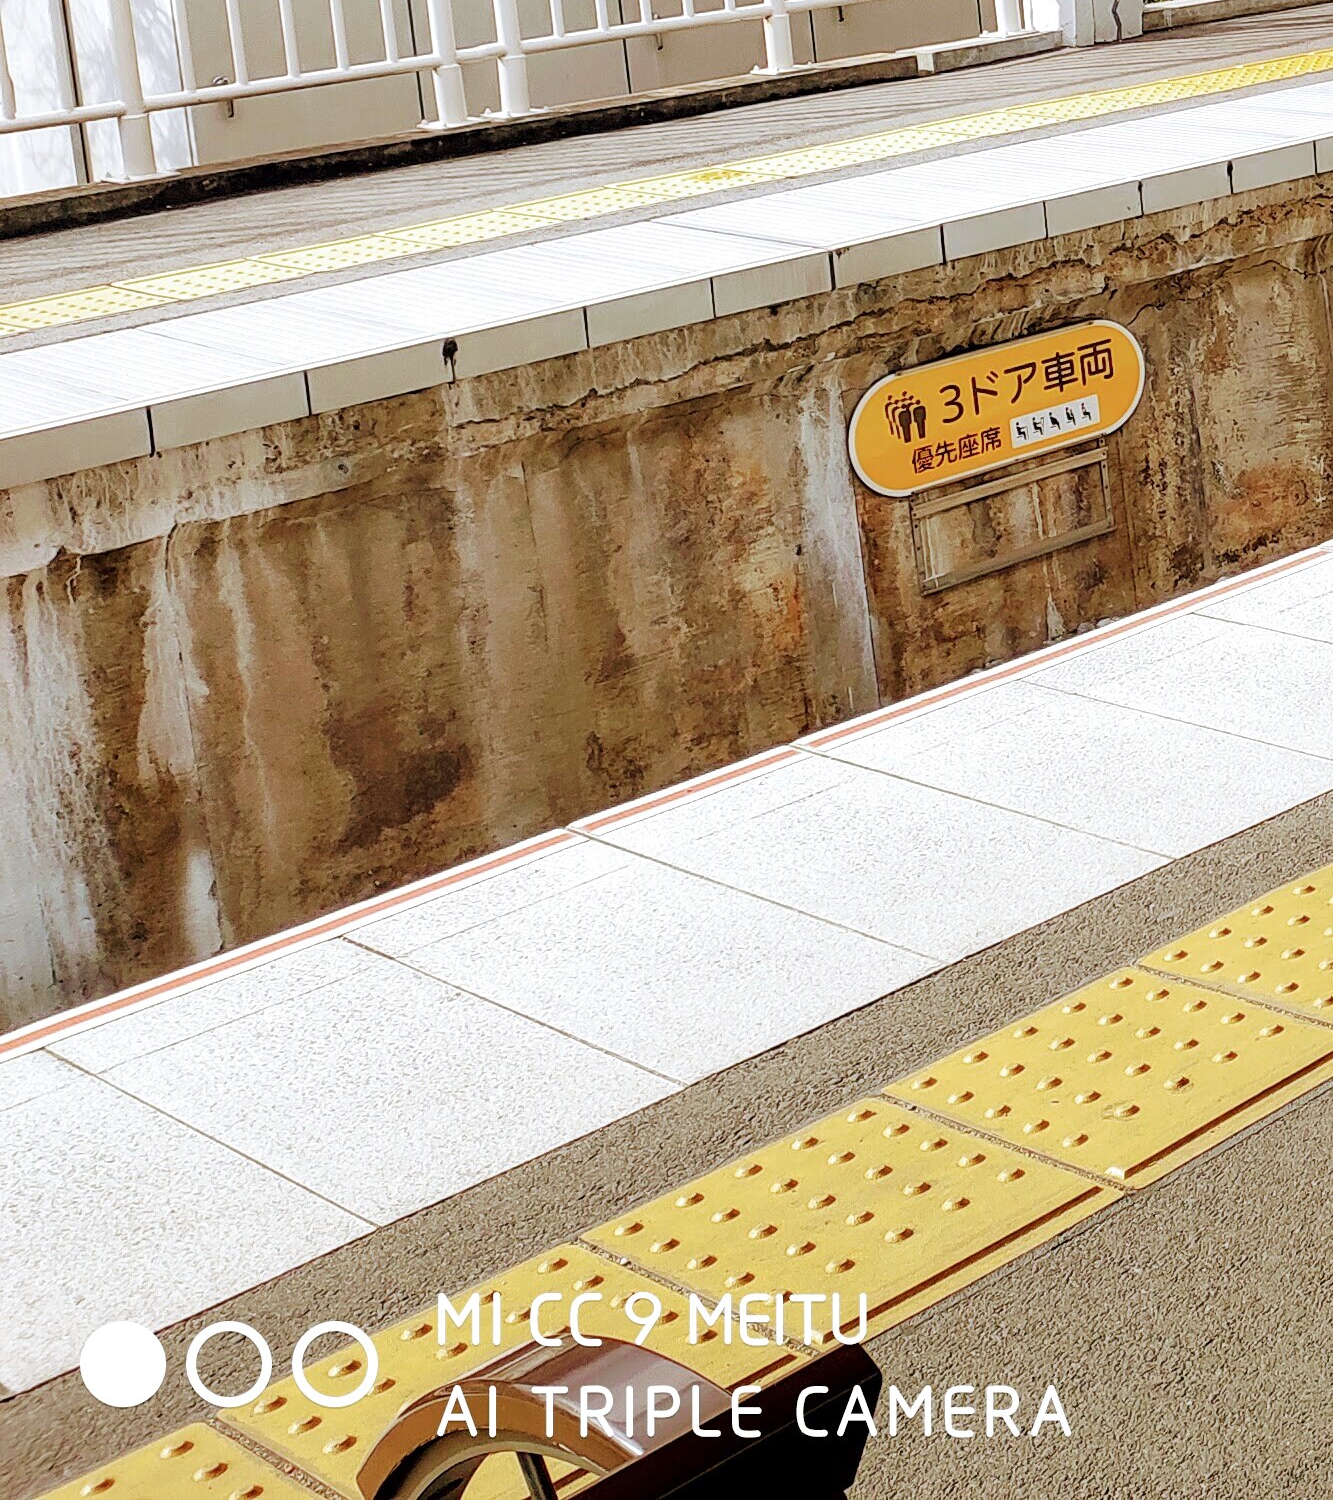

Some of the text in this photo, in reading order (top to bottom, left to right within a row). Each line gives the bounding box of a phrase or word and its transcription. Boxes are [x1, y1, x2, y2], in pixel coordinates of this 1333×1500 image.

[939, 338, 1115, 424] 3ドア車両
[912, 426, 1002, 475] 優先座席
